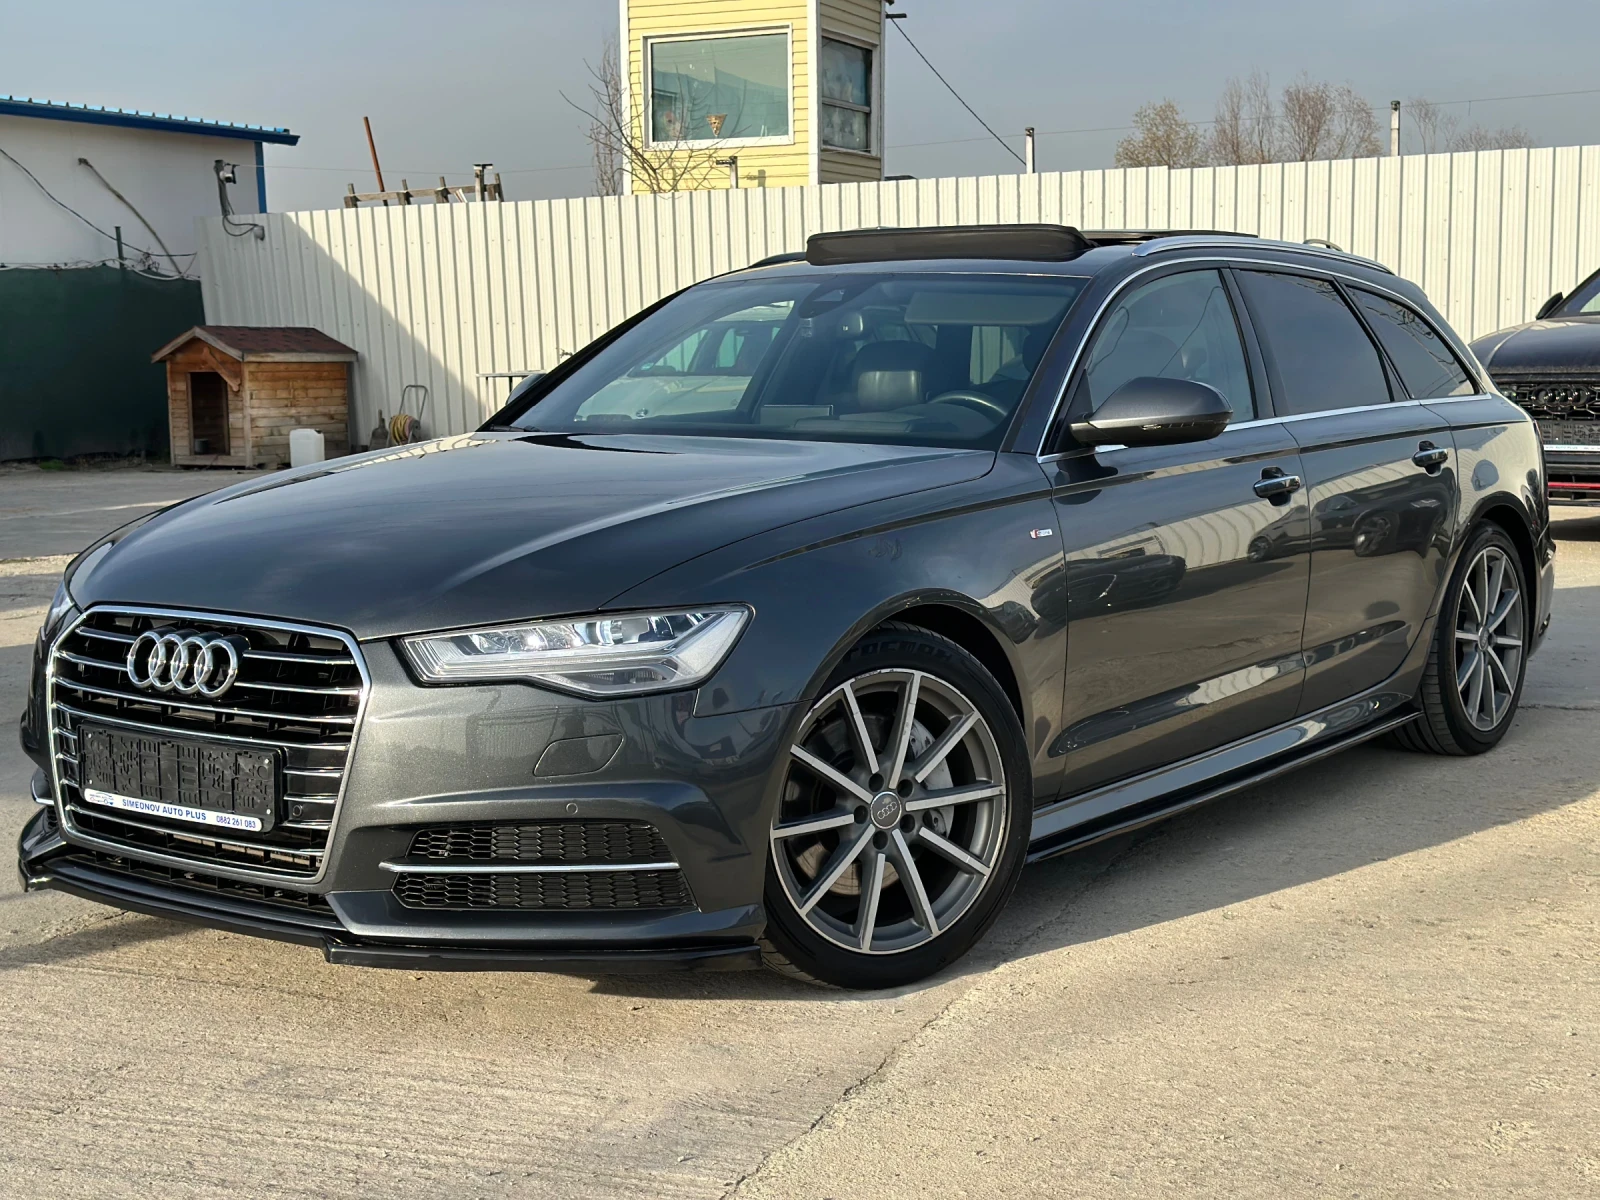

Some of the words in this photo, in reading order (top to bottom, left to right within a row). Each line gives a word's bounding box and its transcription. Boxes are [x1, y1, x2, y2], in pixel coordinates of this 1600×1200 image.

[122, 798, 160, 812] SIMEONOV
[162, 806, 184, 817] AUTO
[186, 809, 207, 821] PLUS
[216, 815, 231, 825] 0882
[232, 817, 243, 827] 261
[244, 819, 256, 829] 083
